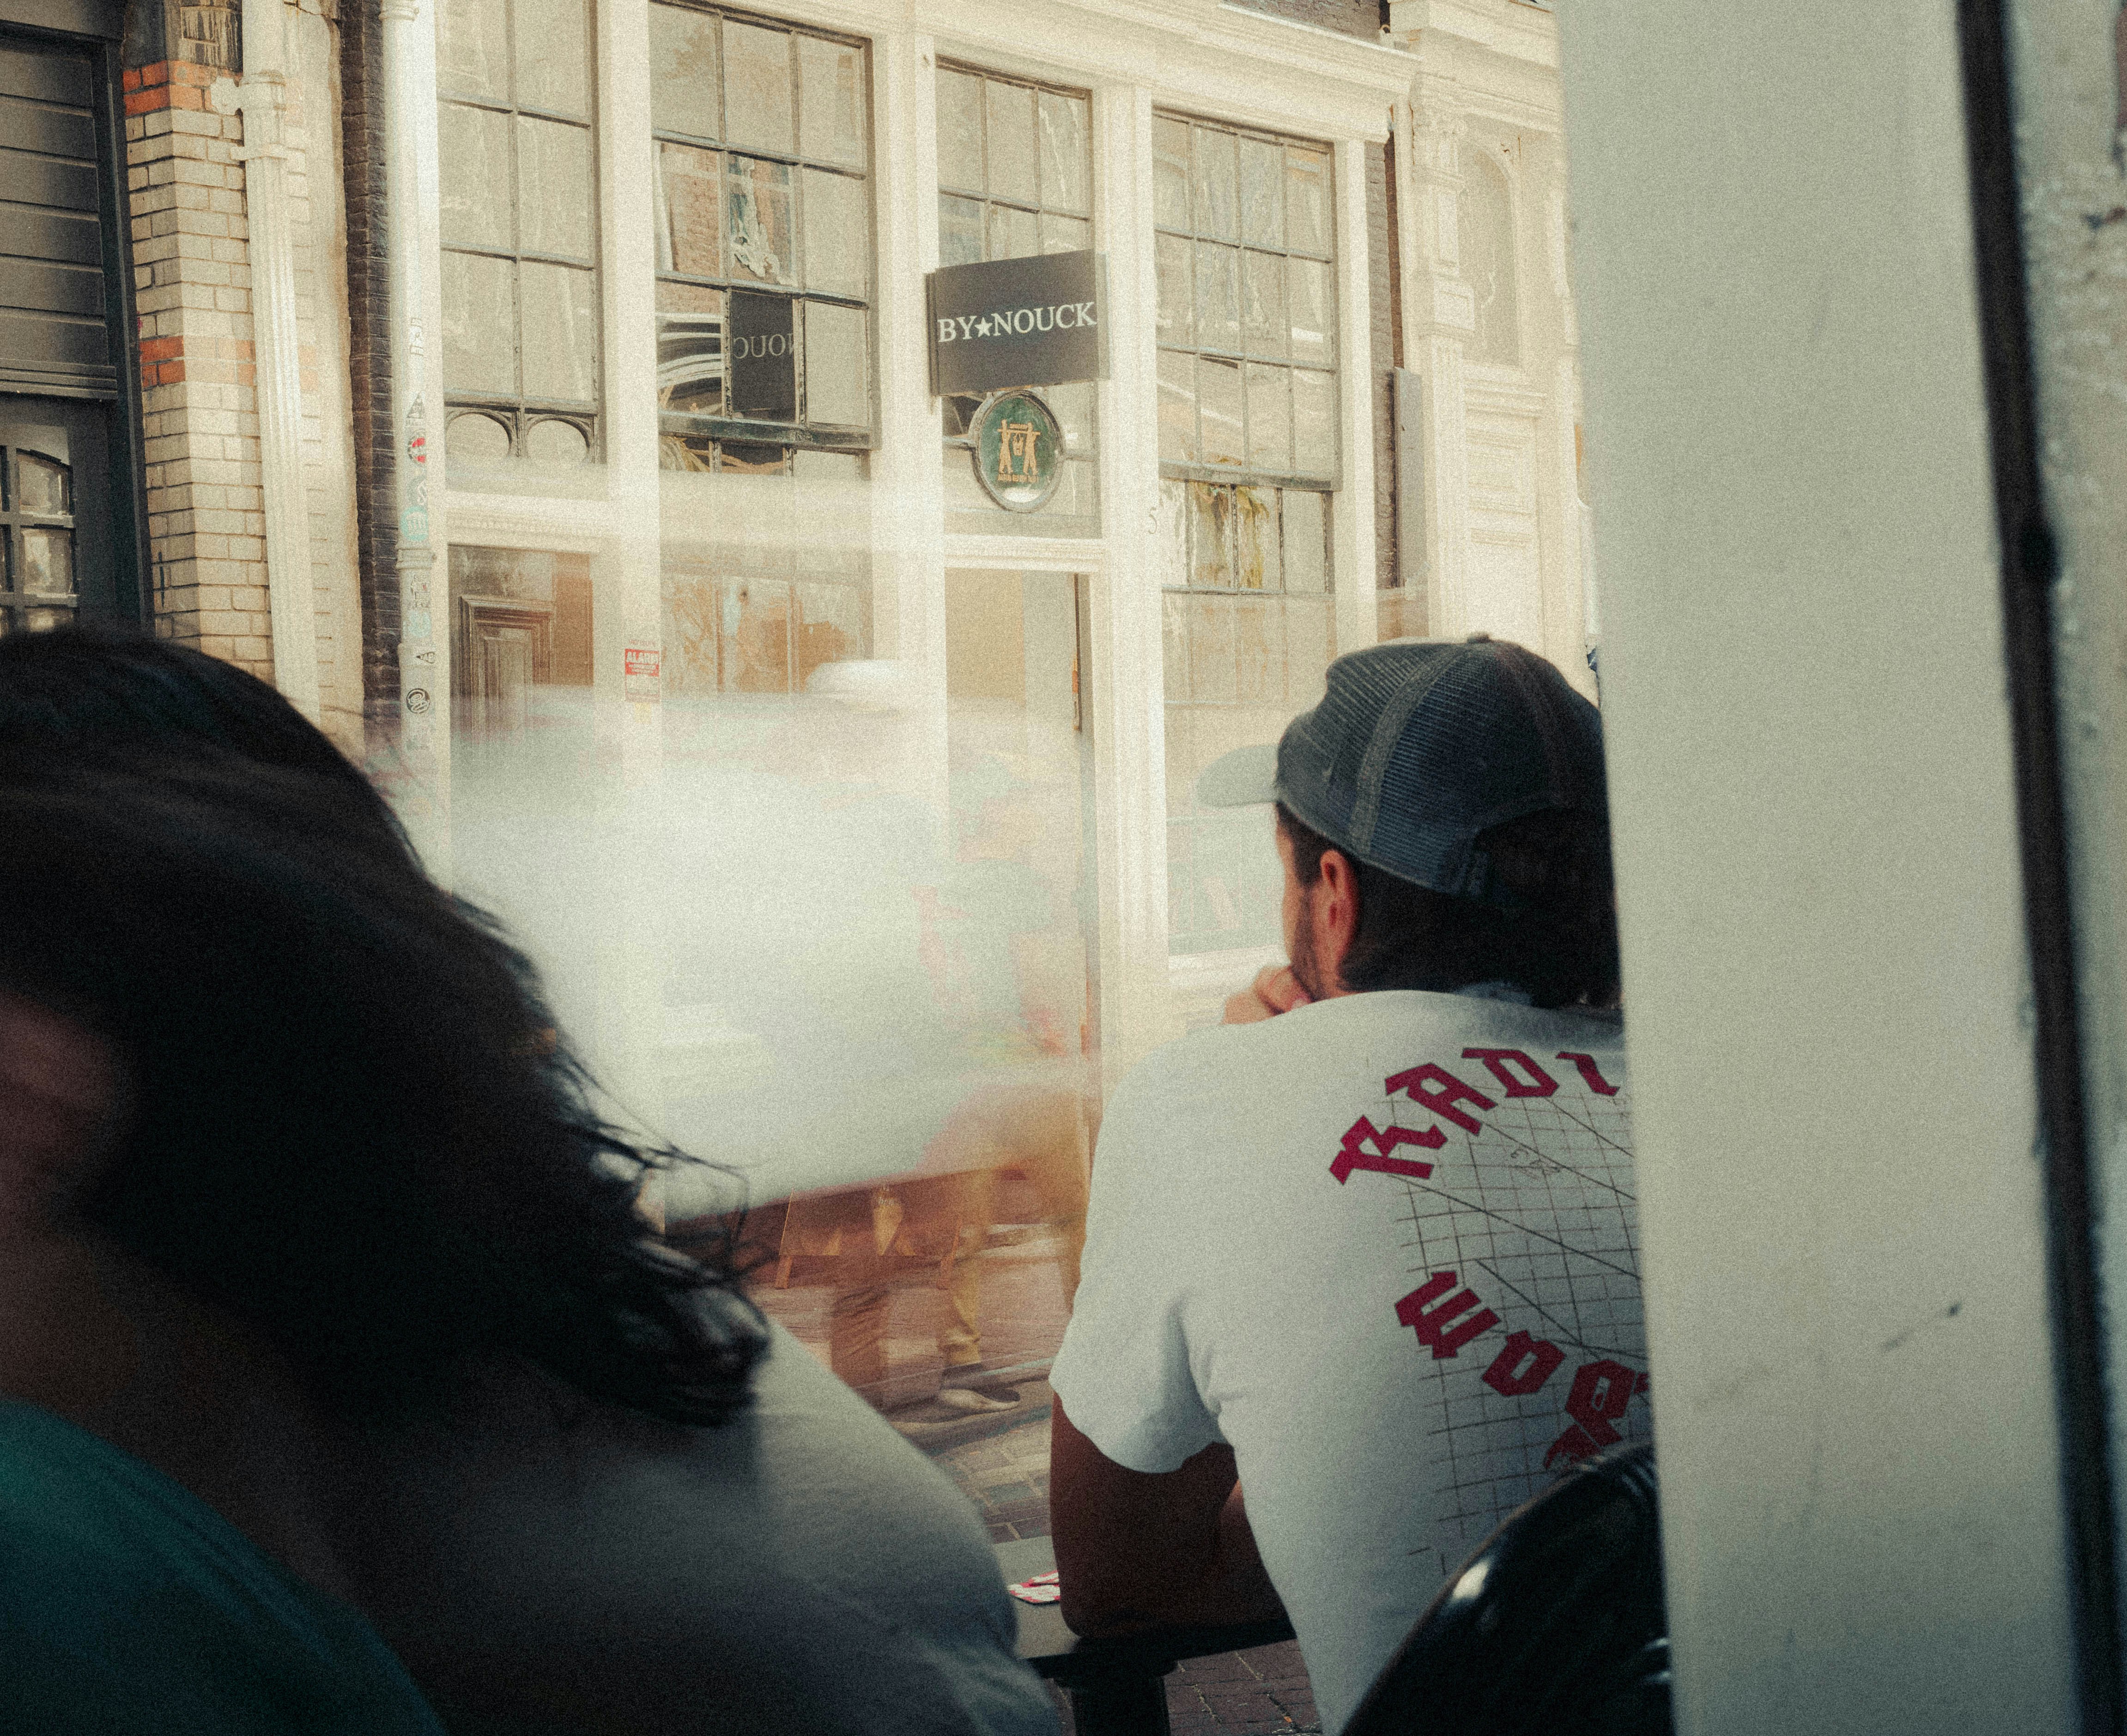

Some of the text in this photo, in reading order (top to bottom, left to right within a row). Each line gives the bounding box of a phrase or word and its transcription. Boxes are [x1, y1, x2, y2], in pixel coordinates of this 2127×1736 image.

[938, 302, 1097, 342] BY NOUCK
[627, 651, 658, 665] ALARM
